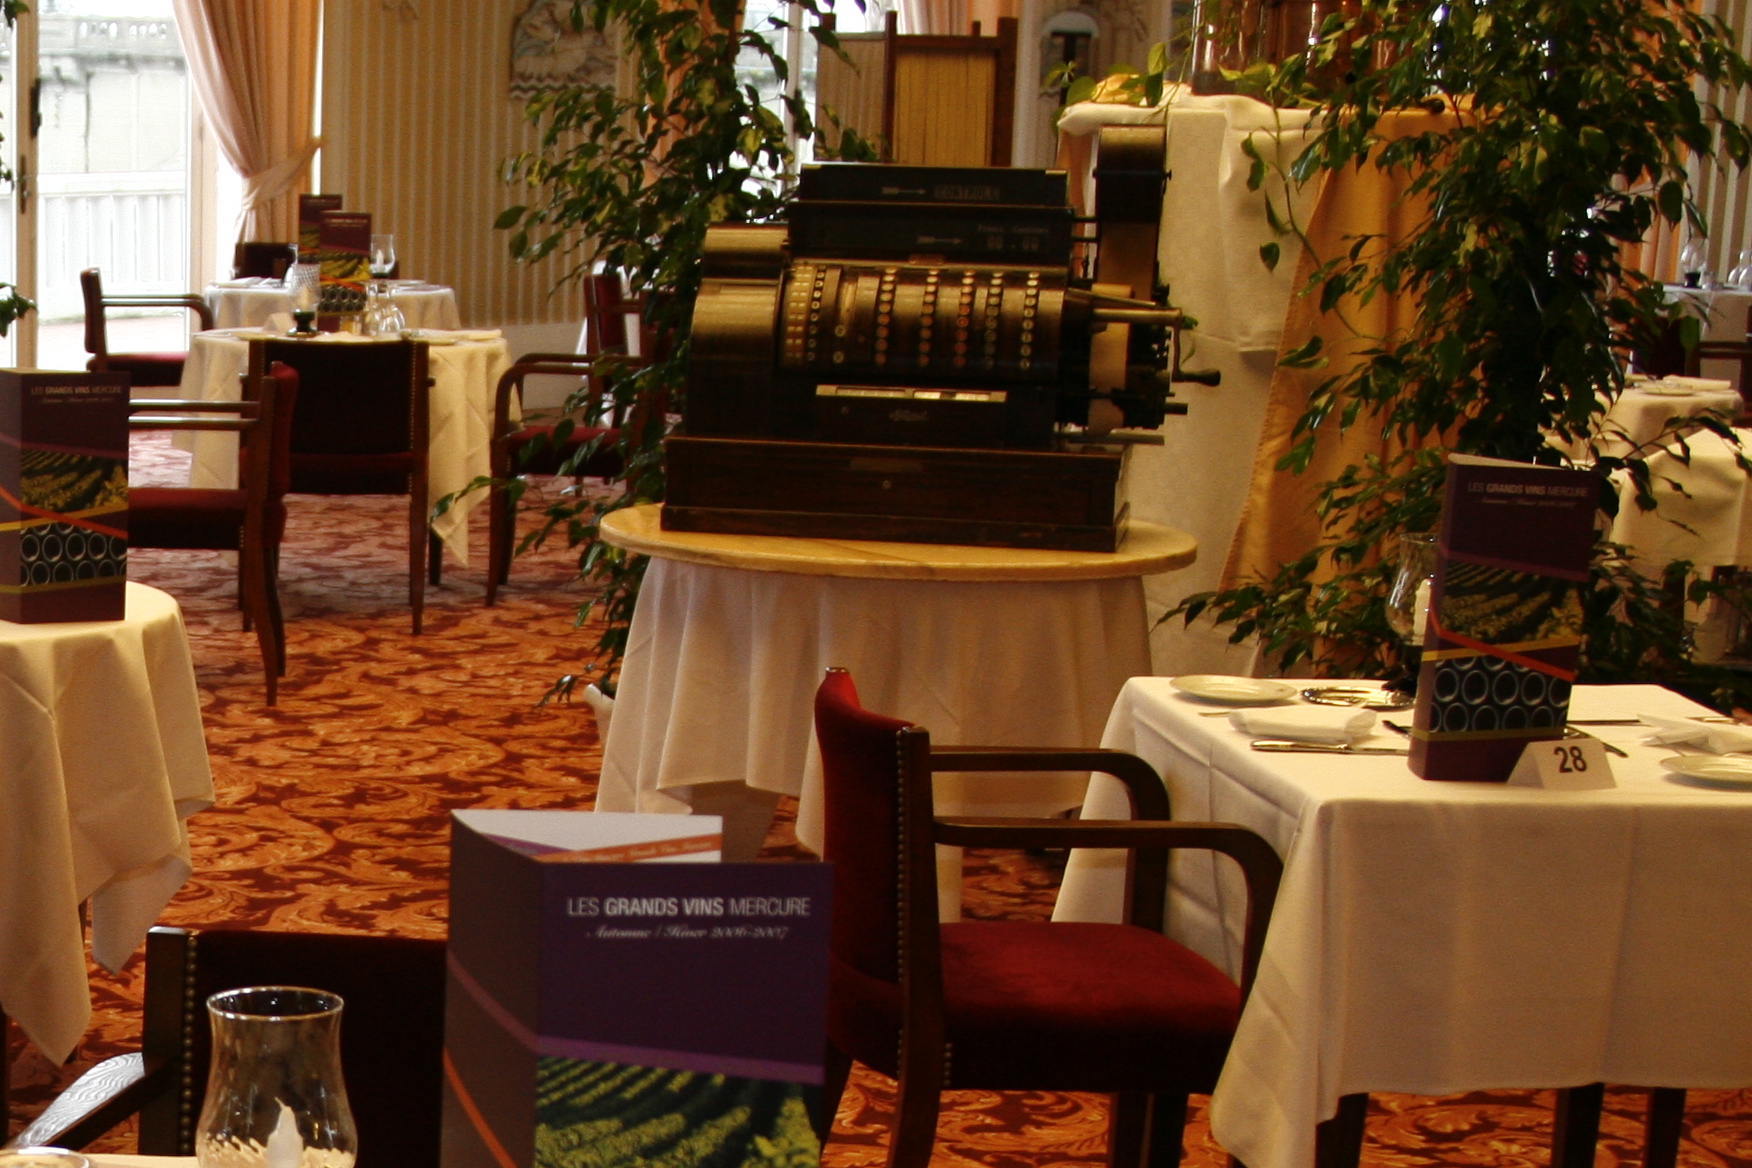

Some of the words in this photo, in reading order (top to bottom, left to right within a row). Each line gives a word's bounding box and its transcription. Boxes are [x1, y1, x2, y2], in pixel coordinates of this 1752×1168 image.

[1467, 482, 1485, 493] LES
[1486, 483, 1523, 495] GRANDS
[1524, 484, 1546, 495] VINS
[1547, 485, 1588, 497] MERCURE
[1553, 745, 1587, 774] 28
[568, 896, 600, 917] LES
[604, 896, 679, 917] GRANDS
[680, 896, 724, 917] VINS
[729, 897, 811, 917] MERCURE
